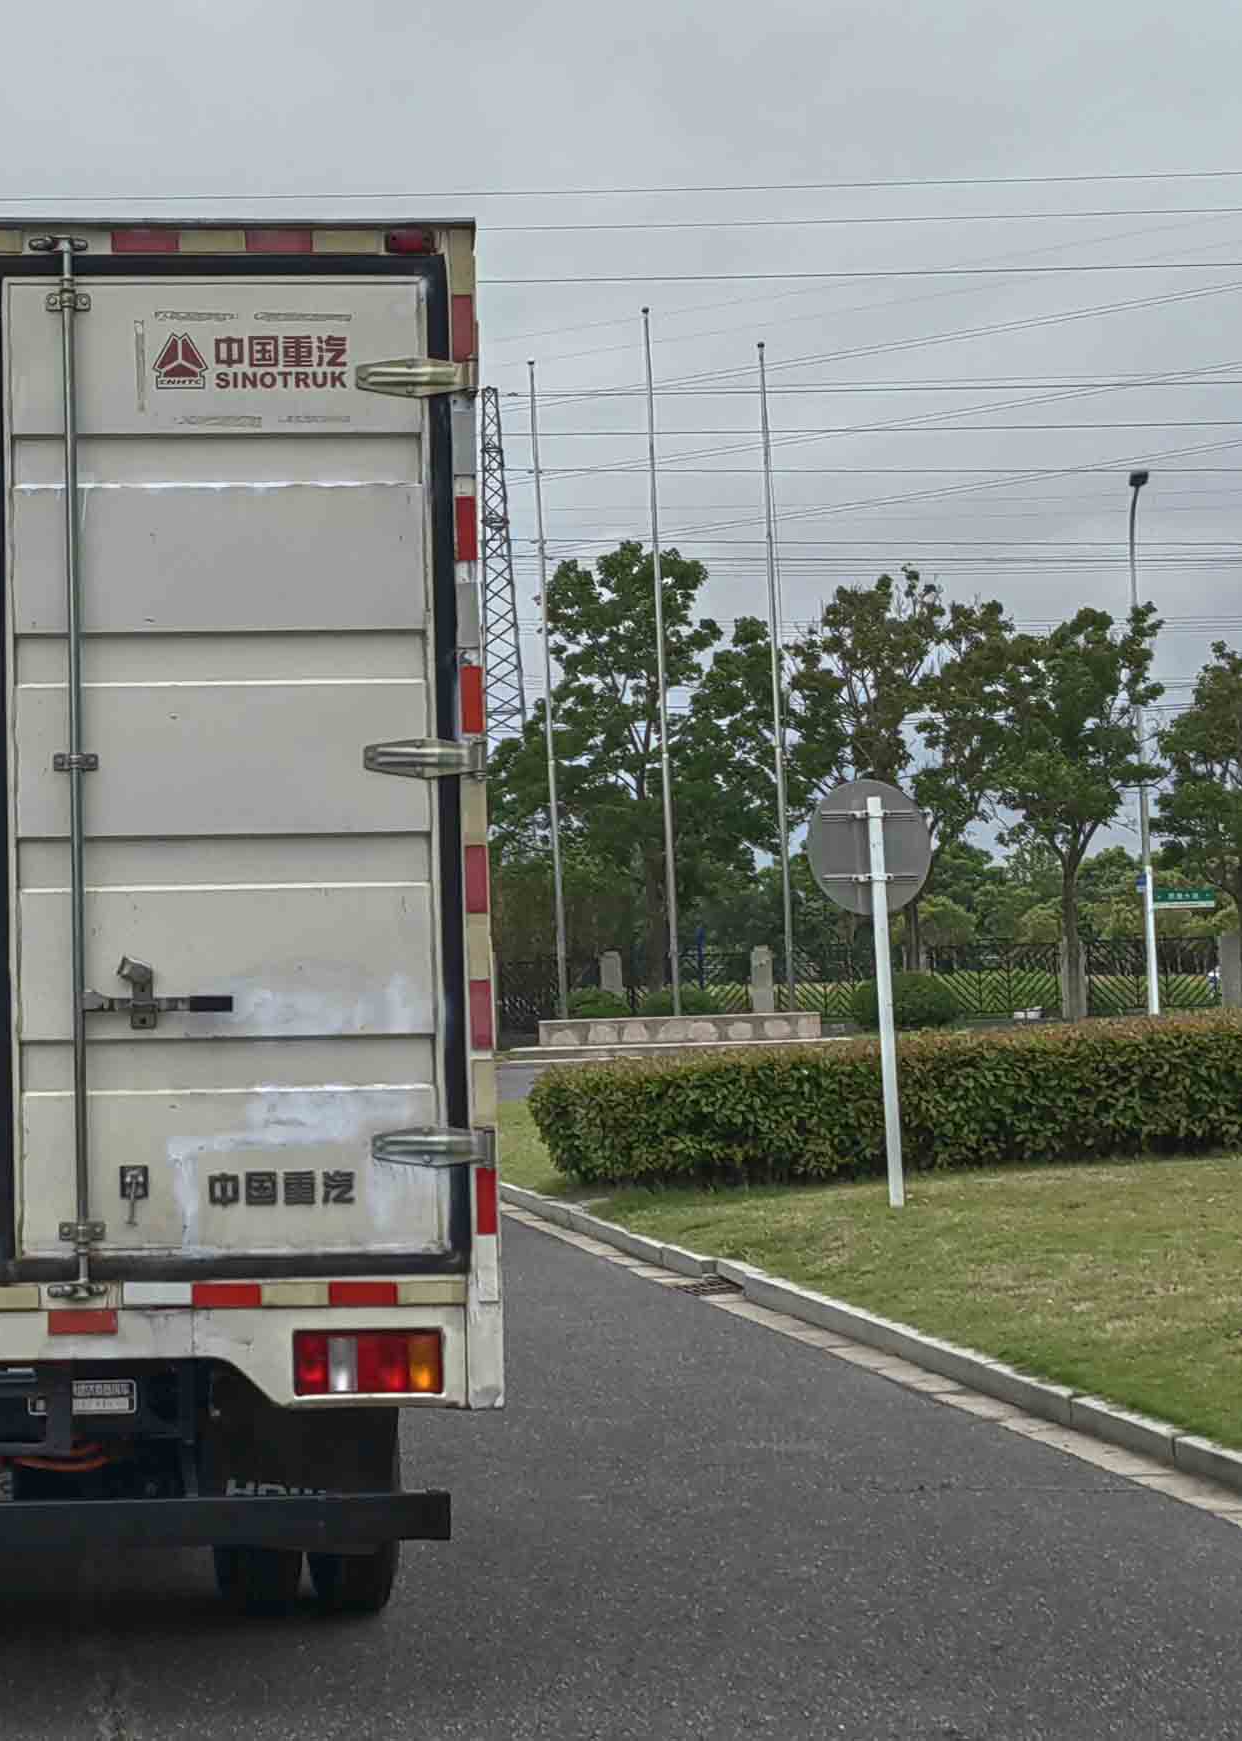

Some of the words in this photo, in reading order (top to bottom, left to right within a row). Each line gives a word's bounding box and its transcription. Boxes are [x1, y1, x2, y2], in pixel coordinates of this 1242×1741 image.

[214, 335, 348, 368] 中国重汽
[215, 371, 348, 389] SINOTRUK
[208, 1171, 356, 1208] 中国重汽
